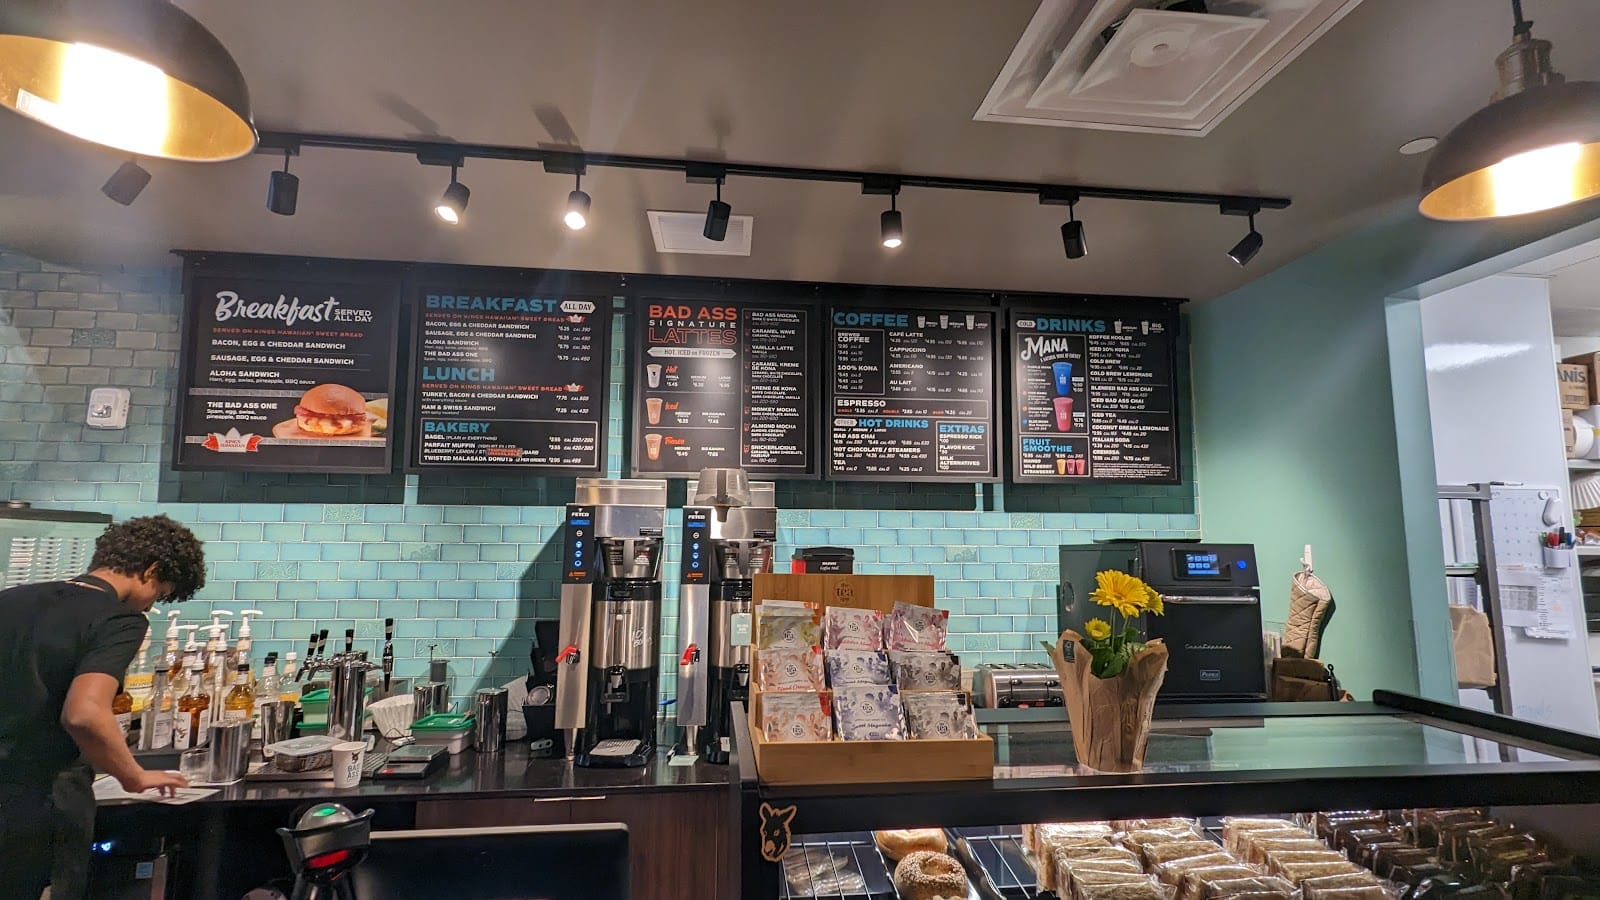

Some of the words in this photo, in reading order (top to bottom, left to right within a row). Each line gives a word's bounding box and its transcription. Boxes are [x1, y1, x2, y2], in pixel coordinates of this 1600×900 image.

[215, 291, 339, 326] Breakfast
[426, 295, 557, 312] BREAKFAST
[649, 305, 691, 319] BAD
[698, 307, 737, 320] ASS
[834, 312, 909, 327] COFFEE
[649, 320, 736, 328] SIGNATURE
[1037, 318, 1105, 332] DRINKS
[649, 328, 737, 345] LATTES
[423, 366, 495, 381] LUNCH
[424, 422, 490, 433] BAKERY
[886, 420, 928, 428] DRINKS
[940, 425, 984, 433] EXTRAS
